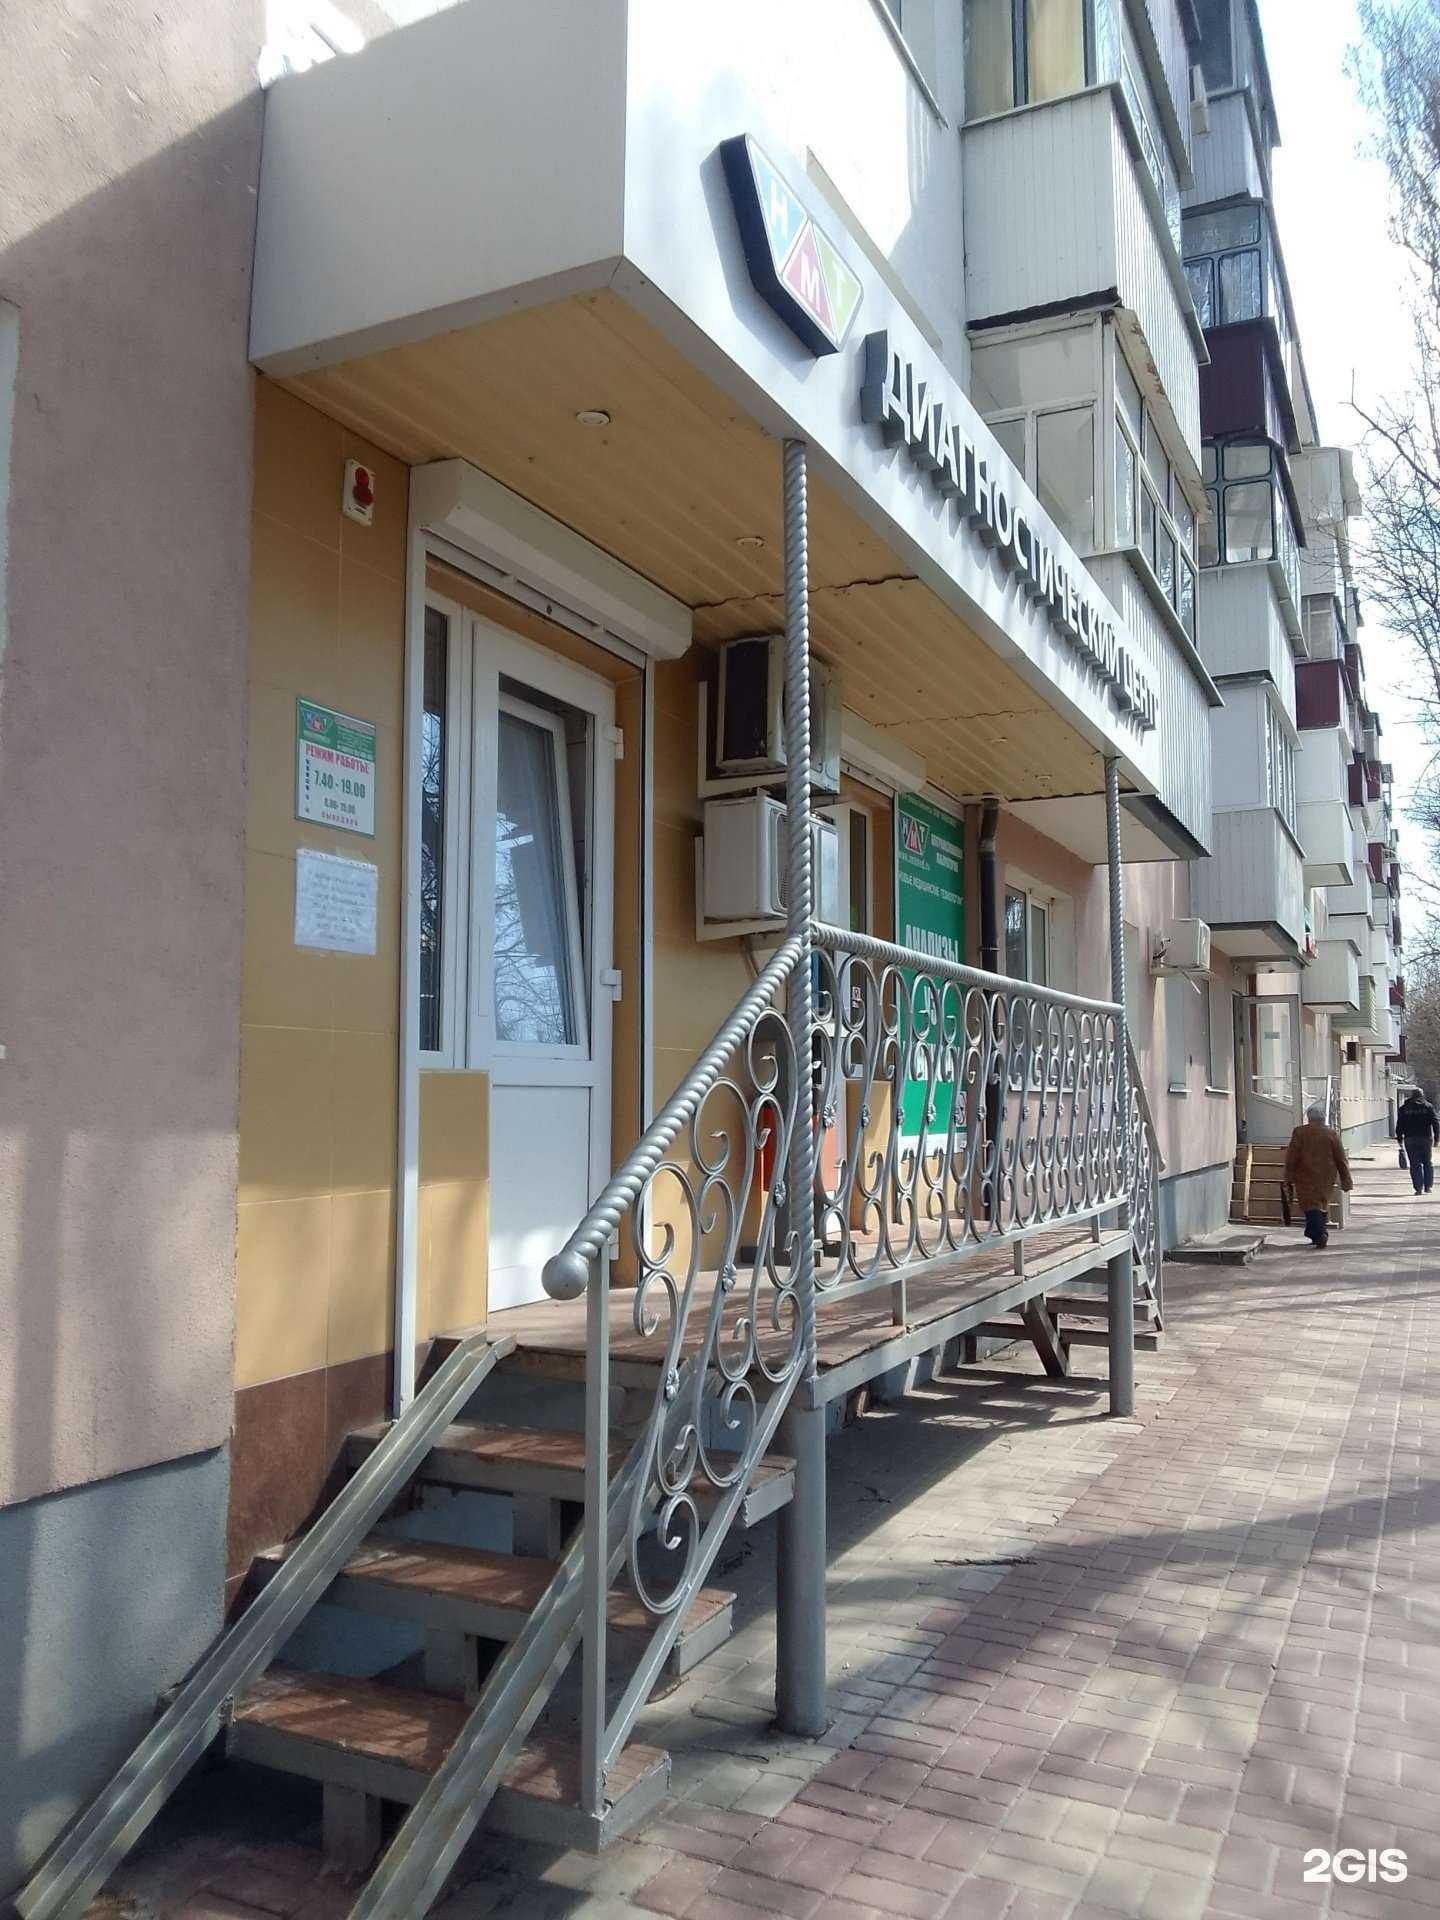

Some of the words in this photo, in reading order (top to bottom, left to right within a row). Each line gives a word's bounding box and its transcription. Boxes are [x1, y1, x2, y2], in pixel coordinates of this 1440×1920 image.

[882, 350, 1120, 684] ДИАГНОСТИЧЕСКИЙ
[306, 744, 334, 765] РЕЖИМ
[313, 770, 334, 790] 7.40
[341, 778, 366, 799] 19.00
